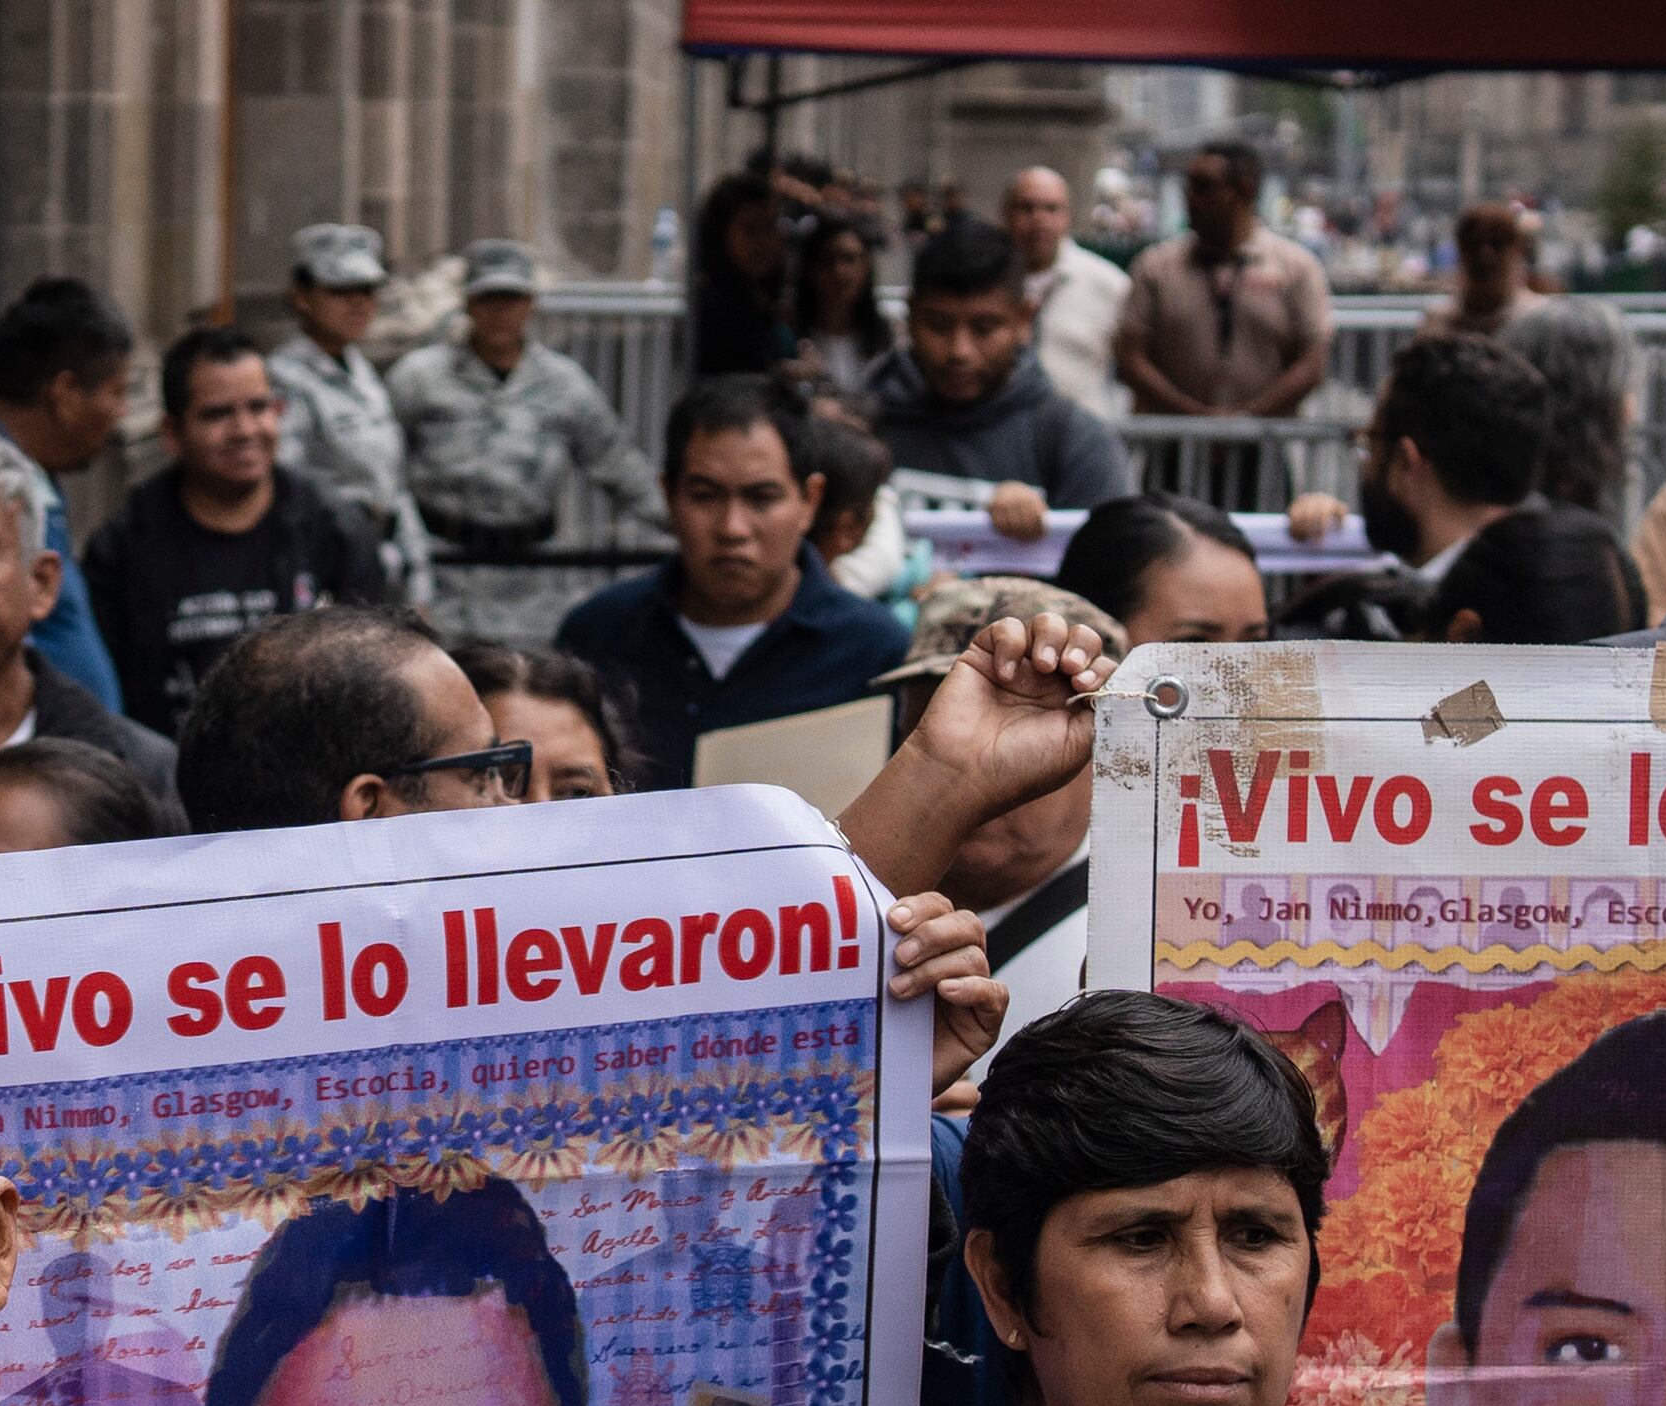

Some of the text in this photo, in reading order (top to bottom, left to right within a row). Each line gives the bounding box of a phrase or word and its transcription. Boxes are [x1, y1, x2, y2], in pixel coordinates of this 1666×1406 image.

[1178, 750, 1433, 867] ¡Vivo
[1469, 774, 1589, 847] se
[166, 954, 287, 1038] se
[317, 921, 409, 1021] lo
[442, 875, 861, 1009] llevaron!
[1184, 896, 1234, 926] Yo,
[1257, 897, 1311, 923] Jan
[23, 1101, 131, 1130] Nimmo,
[151, 1086, 293, 1121] Glasgow,
[314, 1066, 450, 1102] Escocia,
[470, 1053, 576, 1087] quiero
[593, 1040, 676, 1074] saber
[691, 1029, 778, 1061] dónde
[791, 1020, 860, 1048] está
